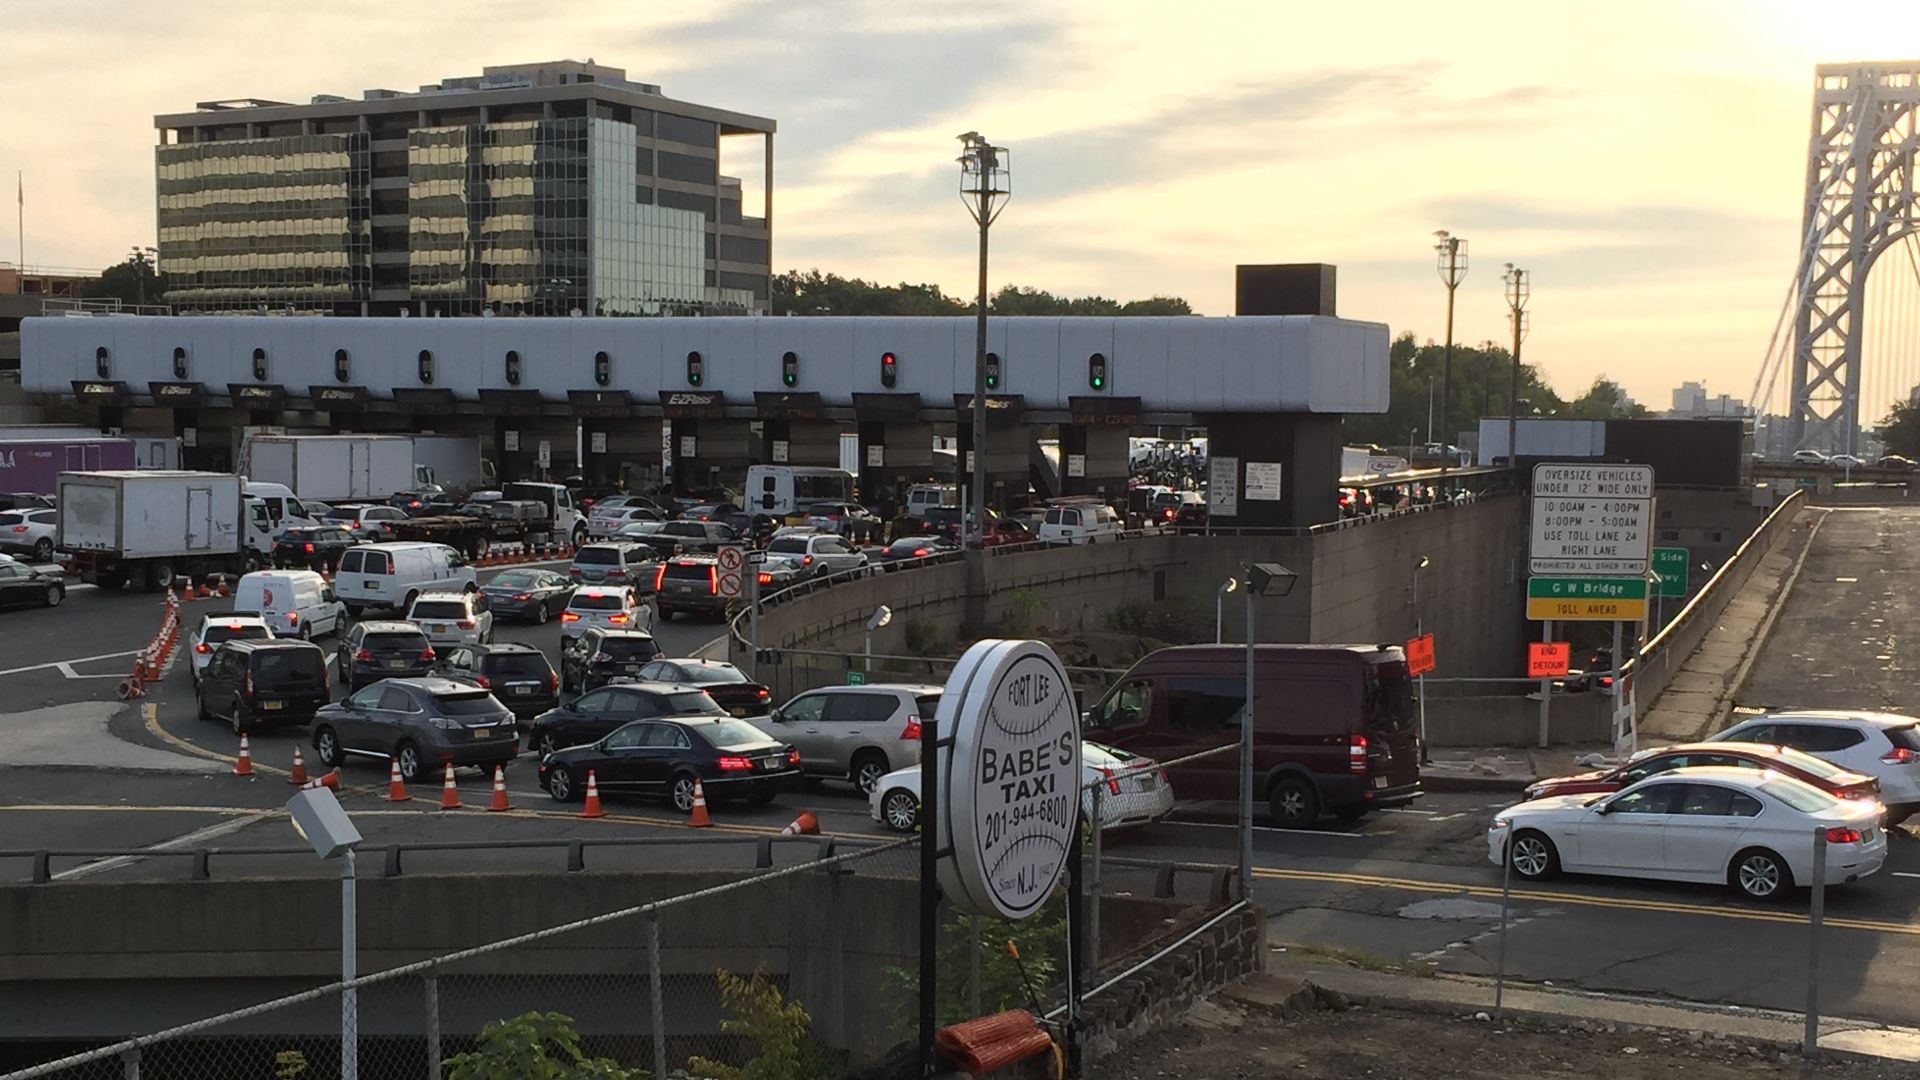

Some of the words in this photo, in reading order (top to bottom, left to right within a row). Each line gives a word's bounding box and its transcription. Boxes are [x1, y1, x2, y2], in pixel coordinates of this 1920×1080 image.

[1545, 470, 1592, 481] OVERSIZE
[1597, 471, 1643, 482] VEHICLES
[1536, 483, 1569, 493] UNDER
[1597, 484, 1620, 494] WIDE
[1624, 484, 1648, 495] ONLY
[1544, 502, 1585, 512] 10:00AM
[1603, 502, 1640, 512] 4:00PM
[1544, 517, 1582, 526] 8:00PM
[1601, 517, 1637, 527] 5:00AM
[1544, 531, 1562, 541] USE
[1568, 531, 1589, 541] TOLL
[1595, 531, 1619, 541] LANE
[1624, 531, 1637, 541] 24
[1561, 545, 1589, 556] RIGHT
[1593, 546, 1617, 556] LANE
[1660, 552, 1683, 561] Side
[1552, 583, 1561, 593] G
[1567, 583, 1578, 593] W
[1583, 583, 1624, 595] Bridge
[1557, 604, 1578, 614] TOLL
[1587, 604, 1617, 615] AHEAD
[1541, 647, 1558, 656] END
[1533, 661, 1565, 670] DETOUR
[1008, 674, 1031, 707] FORT
[1034, 674, 1049, 705] LEE
[982, 730, 1073, 785] BABE'S
[1001, 773, 1055, 804] TAXI
[985, 794, 1067, 850] 201-944-6800
[1017, 863, 1038, 895] N.J.
